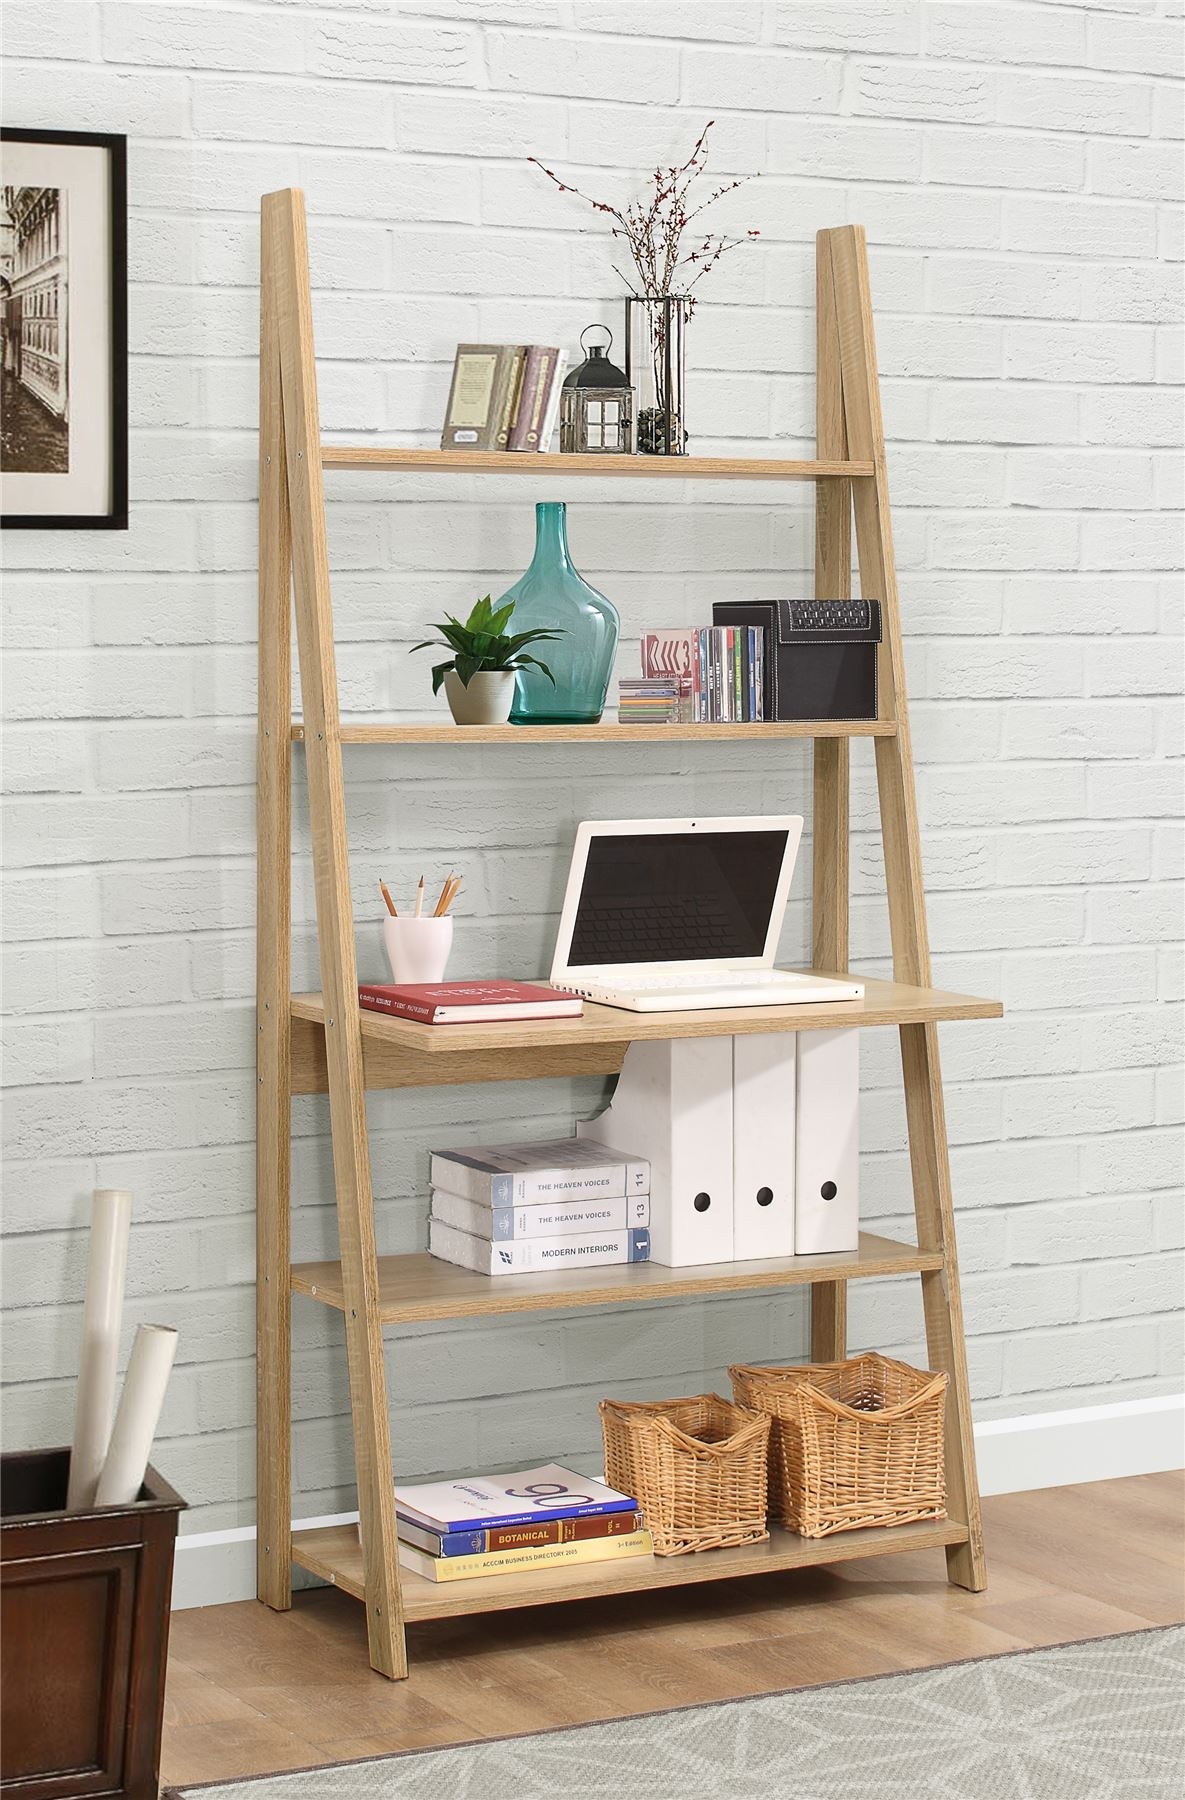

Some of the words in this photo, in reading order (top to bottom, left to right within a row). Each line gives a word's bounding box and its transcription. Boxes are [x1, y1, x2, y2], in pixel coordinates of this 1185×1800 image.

[538, 1183, 552, 1191] THE
[554, 1181, 583, 1190] HEAVEN
[584, 1178, 611, 1187] VOICES
[636, 1172, 644, 1186] 11
[538, 1216, 553, 1224] THE
[555, 1213, 584, 1222] HEAVEN
[585, 1210, 611, 1219] VOICES
[636, 1203, 645, 1218] 13
[541, 1248, 576, 1258] MODERN
[577, 1243, 619, 1255] INTERIORS
[636, 1240, 648, 1250] 1
[498, 1530, 550, 1544] BOTANICAL
[482, 1559, 505, 1568] ACCCIM
[505, 1554, 533, 1565] BUSINESS
[533, 1550, 565, 1561] DIRECTORY
